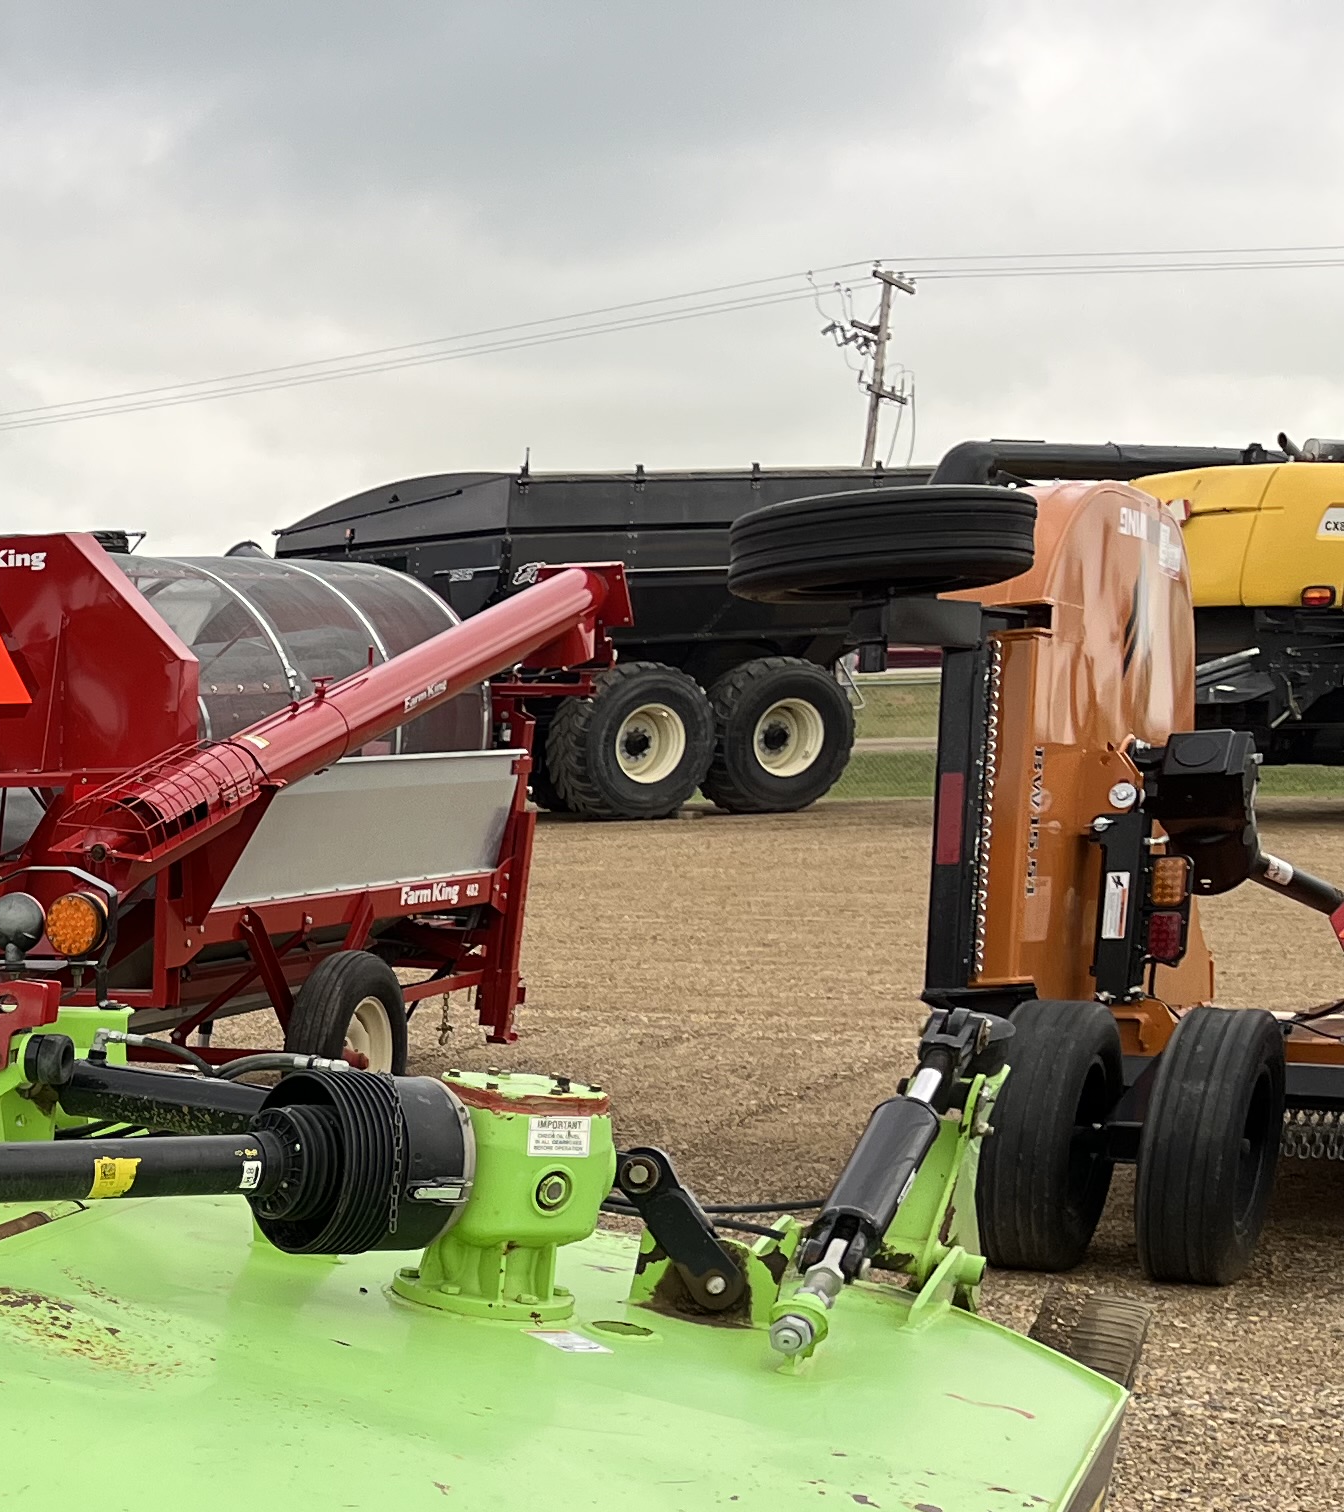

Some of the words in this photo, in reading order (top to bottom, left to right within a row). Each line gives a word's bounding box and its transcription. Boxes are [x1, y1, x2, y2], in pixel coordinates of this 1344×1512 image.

[404, 691, 427, 710] Farm
[427, 681, 448, 697] King
[400, 886, 432, 906] Farm
[432, 882, 460, 905] King
[537, 1120, 583, 1130] IMPORTANT
